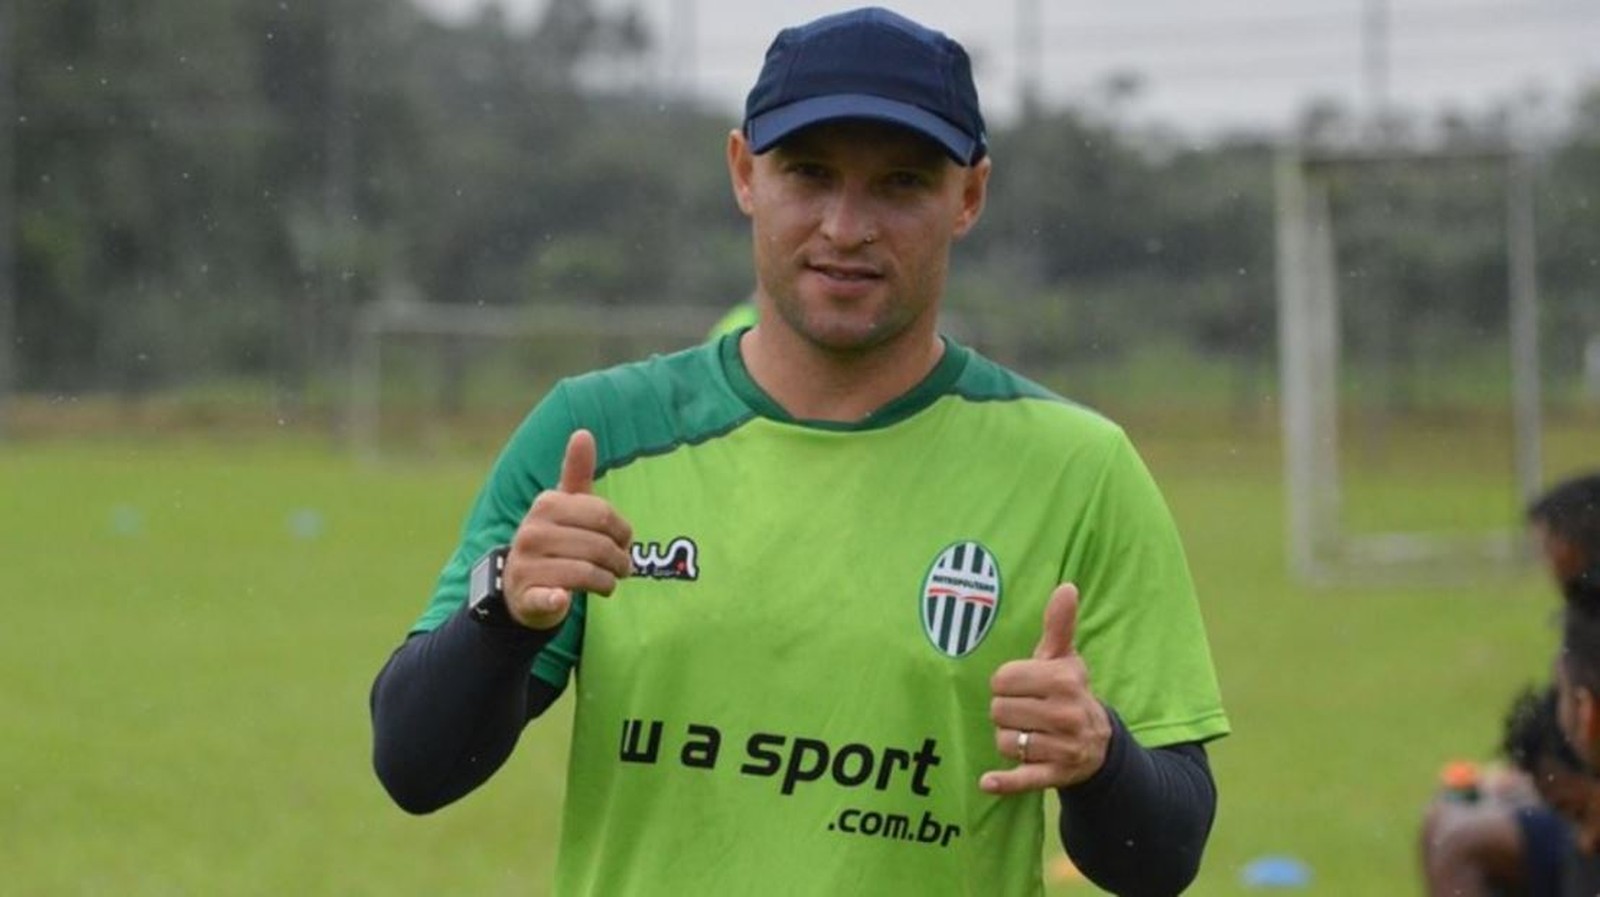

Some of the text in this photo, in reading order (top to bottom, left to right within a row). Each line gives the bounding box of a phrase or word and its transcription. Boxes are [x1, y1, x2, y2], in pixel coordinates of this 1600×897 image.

[681, 724, 721, 769] a
[740, 733, 941, 797] sport
[827, 809, 961, 847] .com.br
